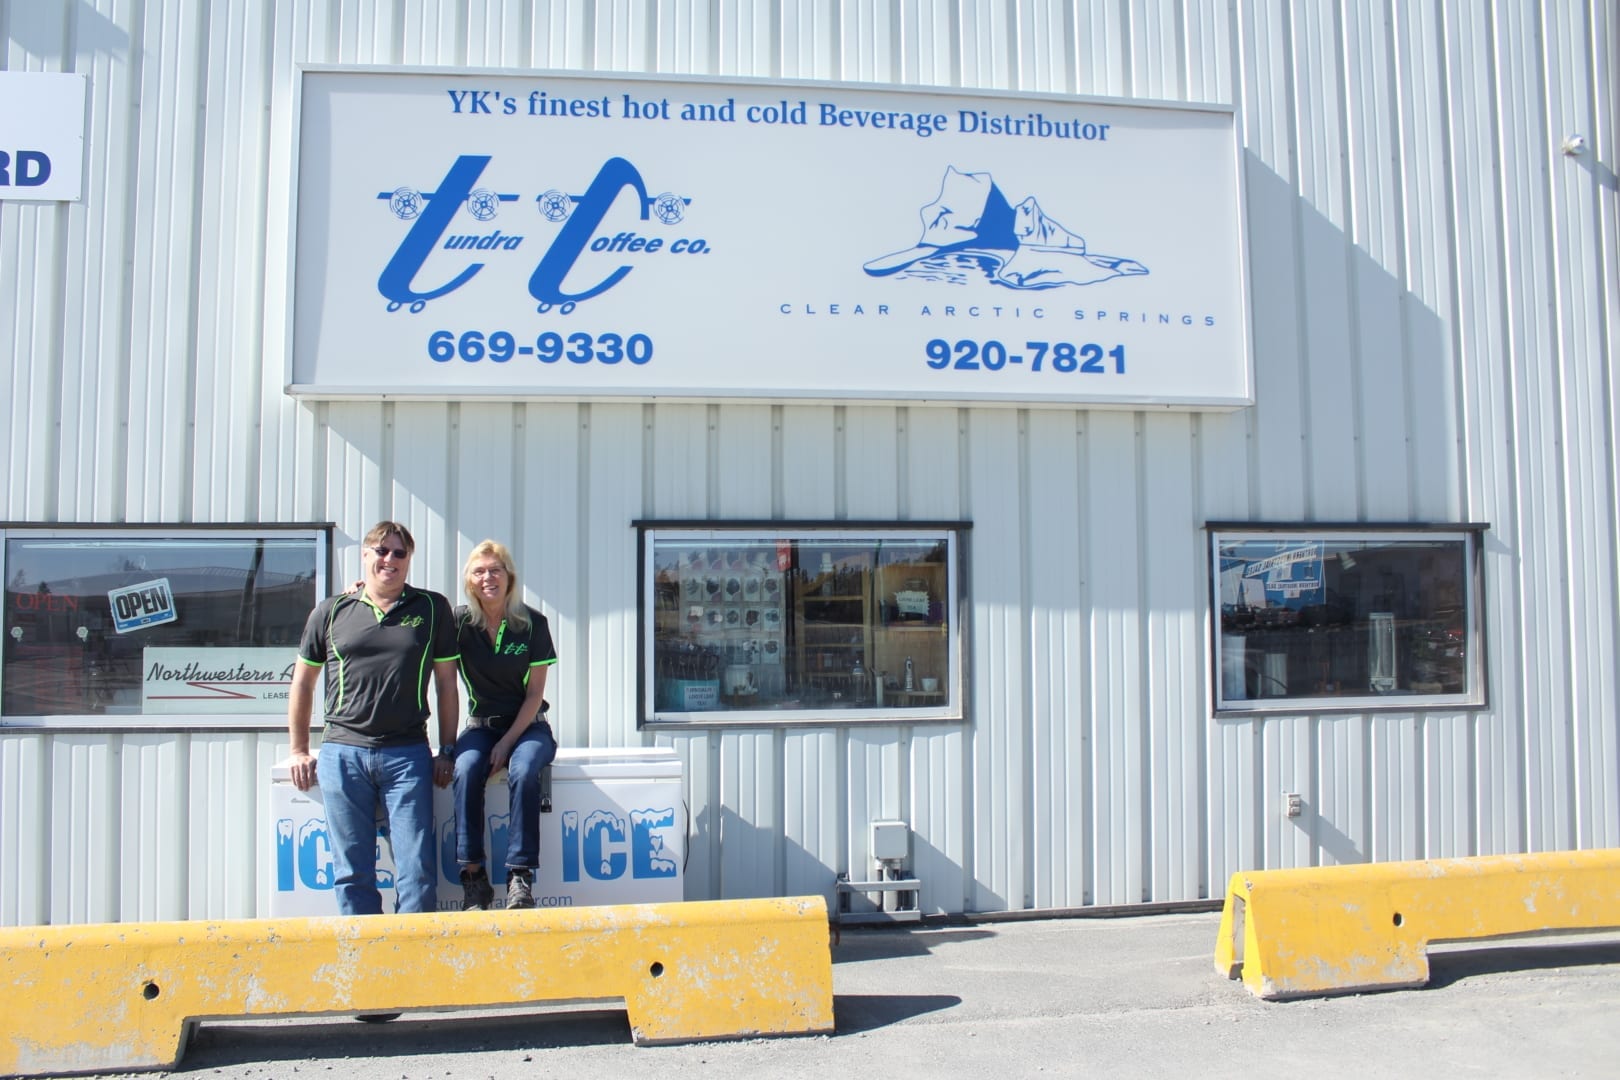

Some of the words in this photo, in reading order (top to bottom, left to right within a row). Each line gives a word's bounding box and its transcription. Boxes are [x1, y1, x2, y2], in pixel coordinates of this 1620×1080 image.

[447, 88, 518, 115] YK's
[528, 89, 611, 118] finest
[622, 92, 670, 120] hot
[680, 97, 736, 122] and
[746, 99, 807, 125] cold
[819, 102, 949, 137] Beverage
[959, 109, 1111, 141] Distributor
[669, 237, 711, 254] co.
[780, 303, 891, 316] CLEAR
[922, 305, 1043, 318] ARCTIC
[1075, 309, 1215, 326] SPRINGS
[426, 329, 654, 365] 669-9330
[925, 338, 1127, 375] 920-7821
[16, 592, 79, 612] OPEN
[116, 585, 168, 619] OPEN
[147, 662, 275, 681] Northwestern
[560, 805, 678, 885] ICE
